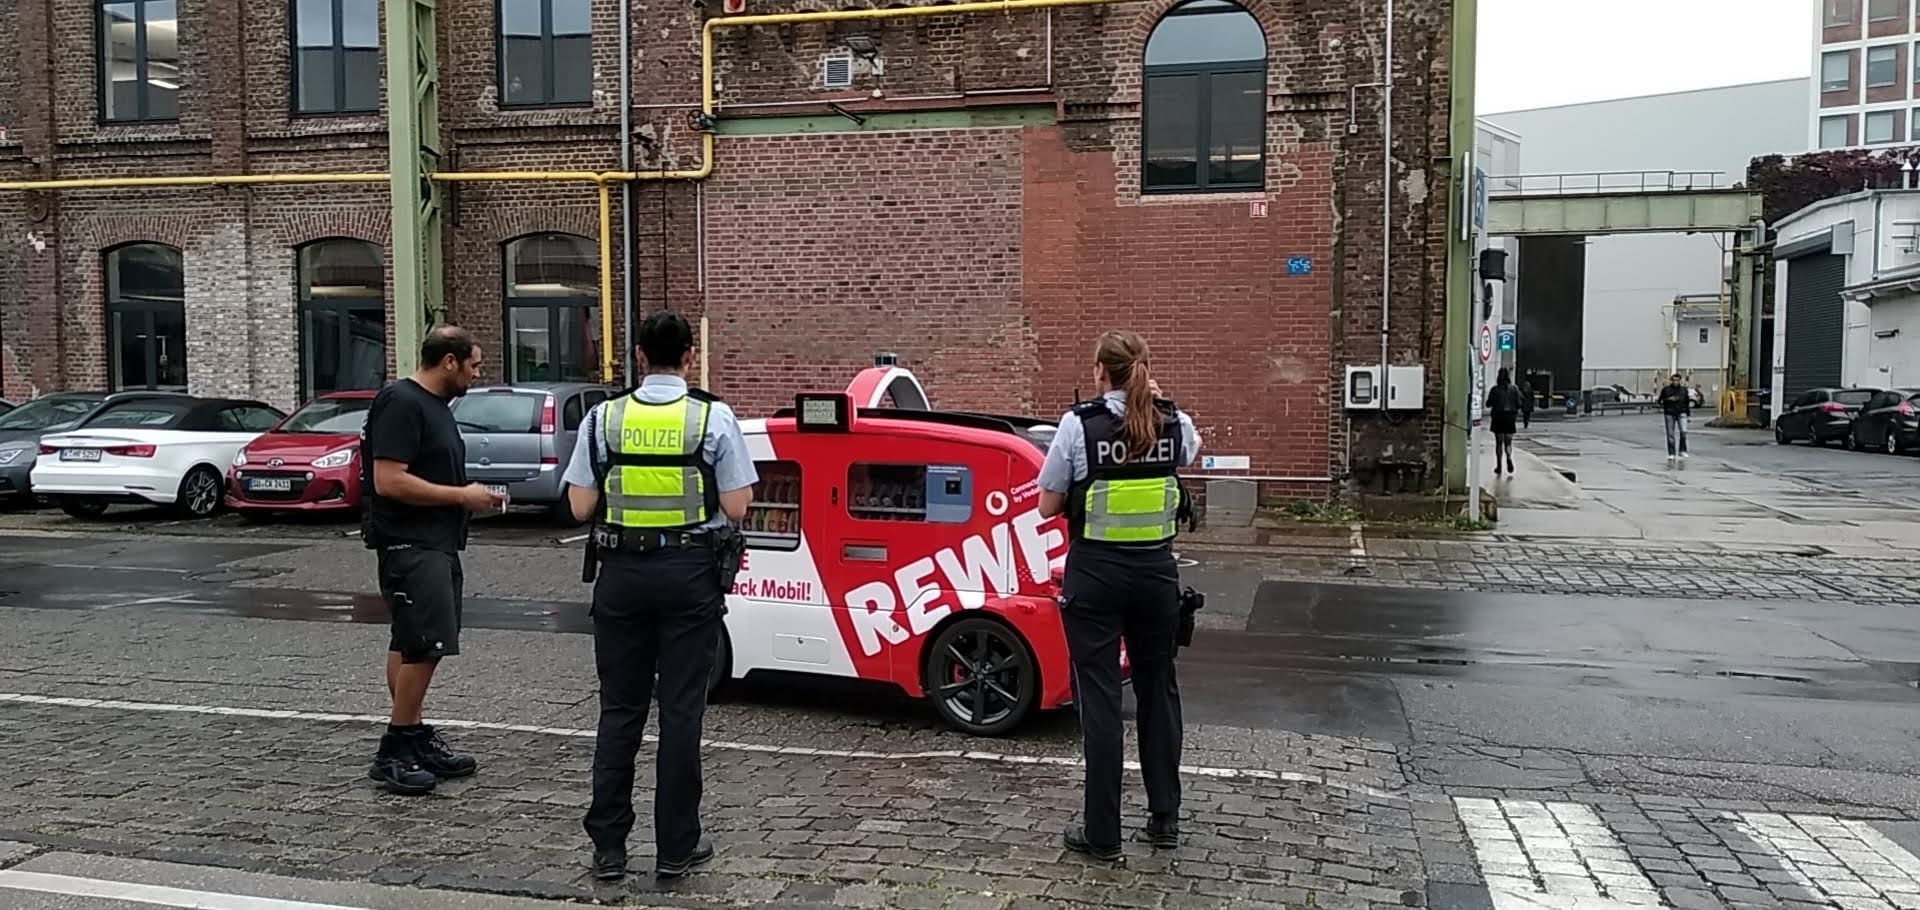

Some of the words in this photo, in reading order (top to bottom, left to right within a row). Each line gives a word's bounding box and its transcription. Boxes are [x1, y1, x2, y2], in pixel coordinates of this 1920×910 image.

[623, 428, 681, 448] POLIZEI
[1096, 437, 1175, 464] POZEI
[729, 578, 757, 597] ack
[761, 579, 811, 602] Mobil!
[845, 507, 1068, 656] REWE
